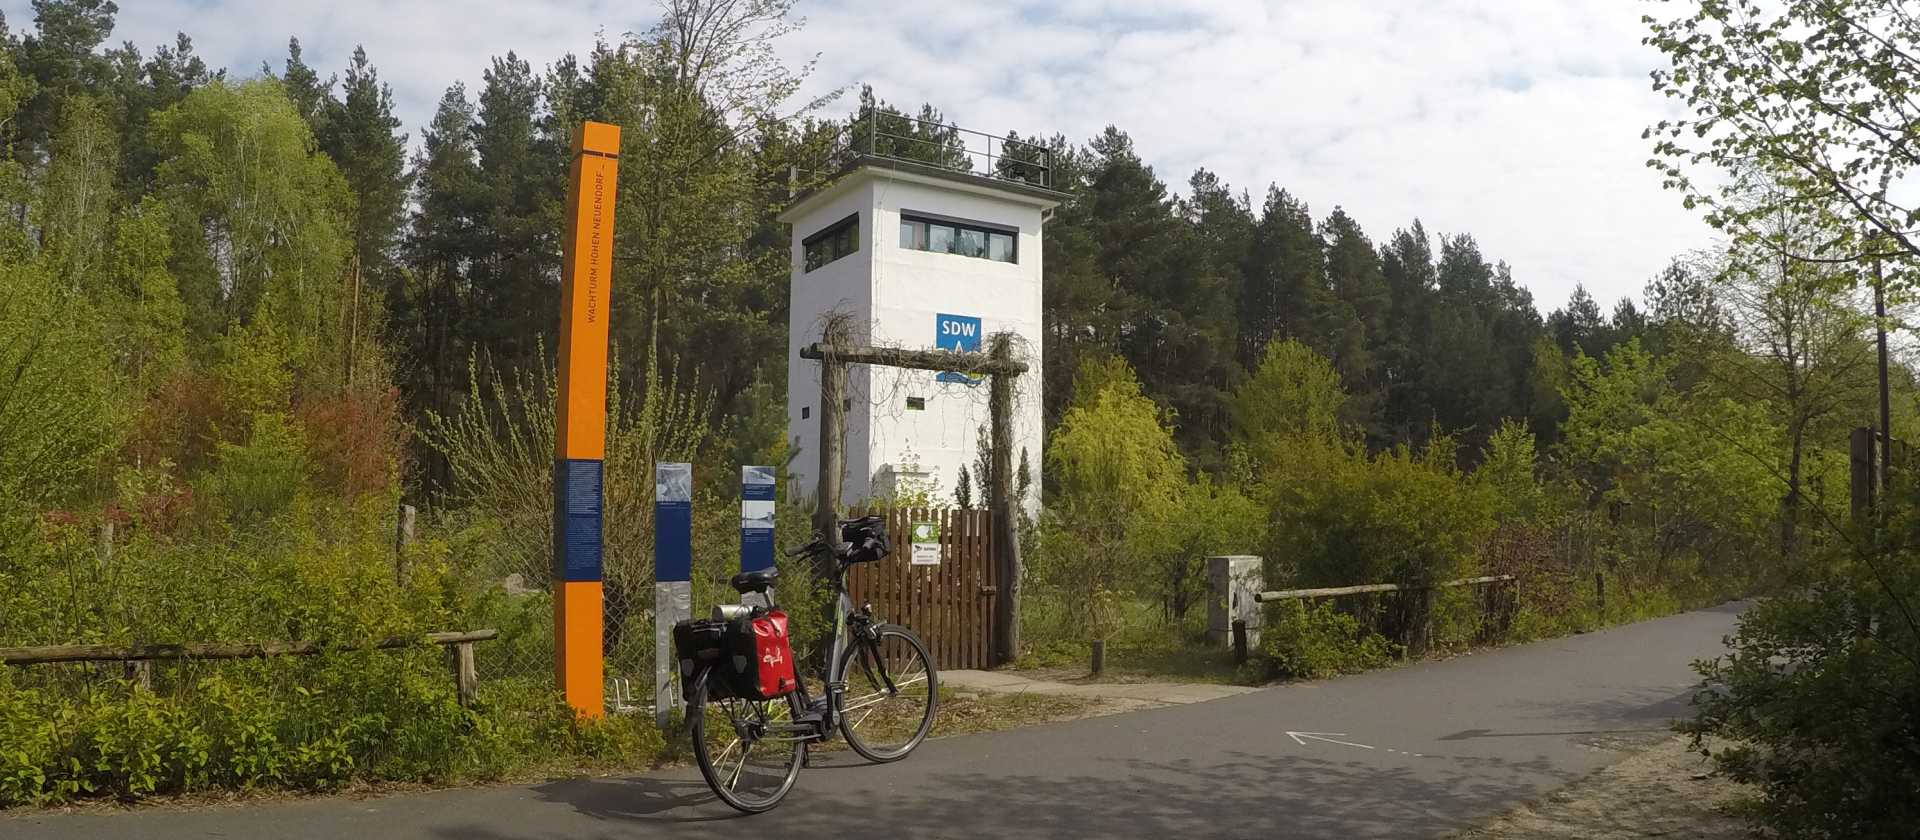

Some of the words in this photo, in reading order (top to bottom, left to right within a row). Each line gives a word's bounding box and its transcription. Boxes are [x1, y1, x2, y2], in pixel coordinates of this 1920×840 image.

[592, 172, 604, 231] NEUENDORF
[590, 231, 600, 266] HOHEN
[588, 269, 598, 323] WACHTURM
[942, 320, 976, 337] SDW
